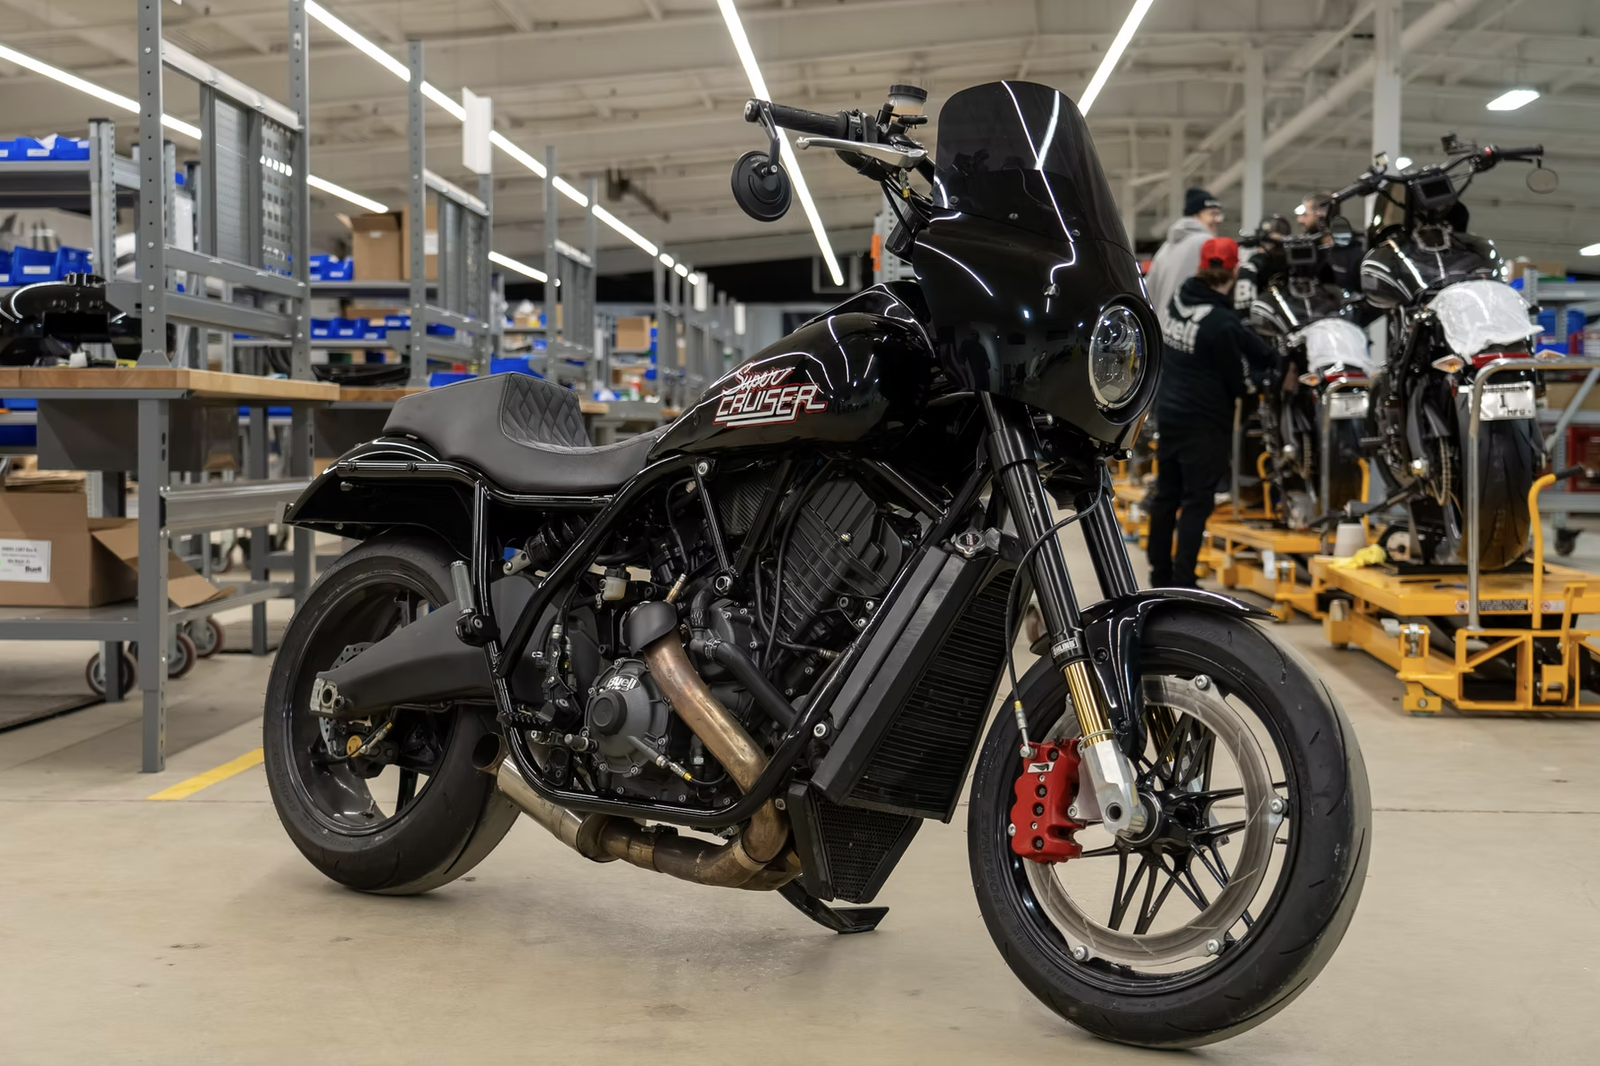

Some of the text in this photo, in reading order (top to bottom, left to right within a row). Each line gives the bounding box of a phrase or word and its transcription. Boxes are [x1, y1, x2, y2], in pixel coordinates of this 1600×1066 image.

[1163, 317, 1199, 346] uell
[723, 362, 796, 396] Super
[715, 384, 826, 422] CRUISER
[607, 676, 637, 690] Buell
